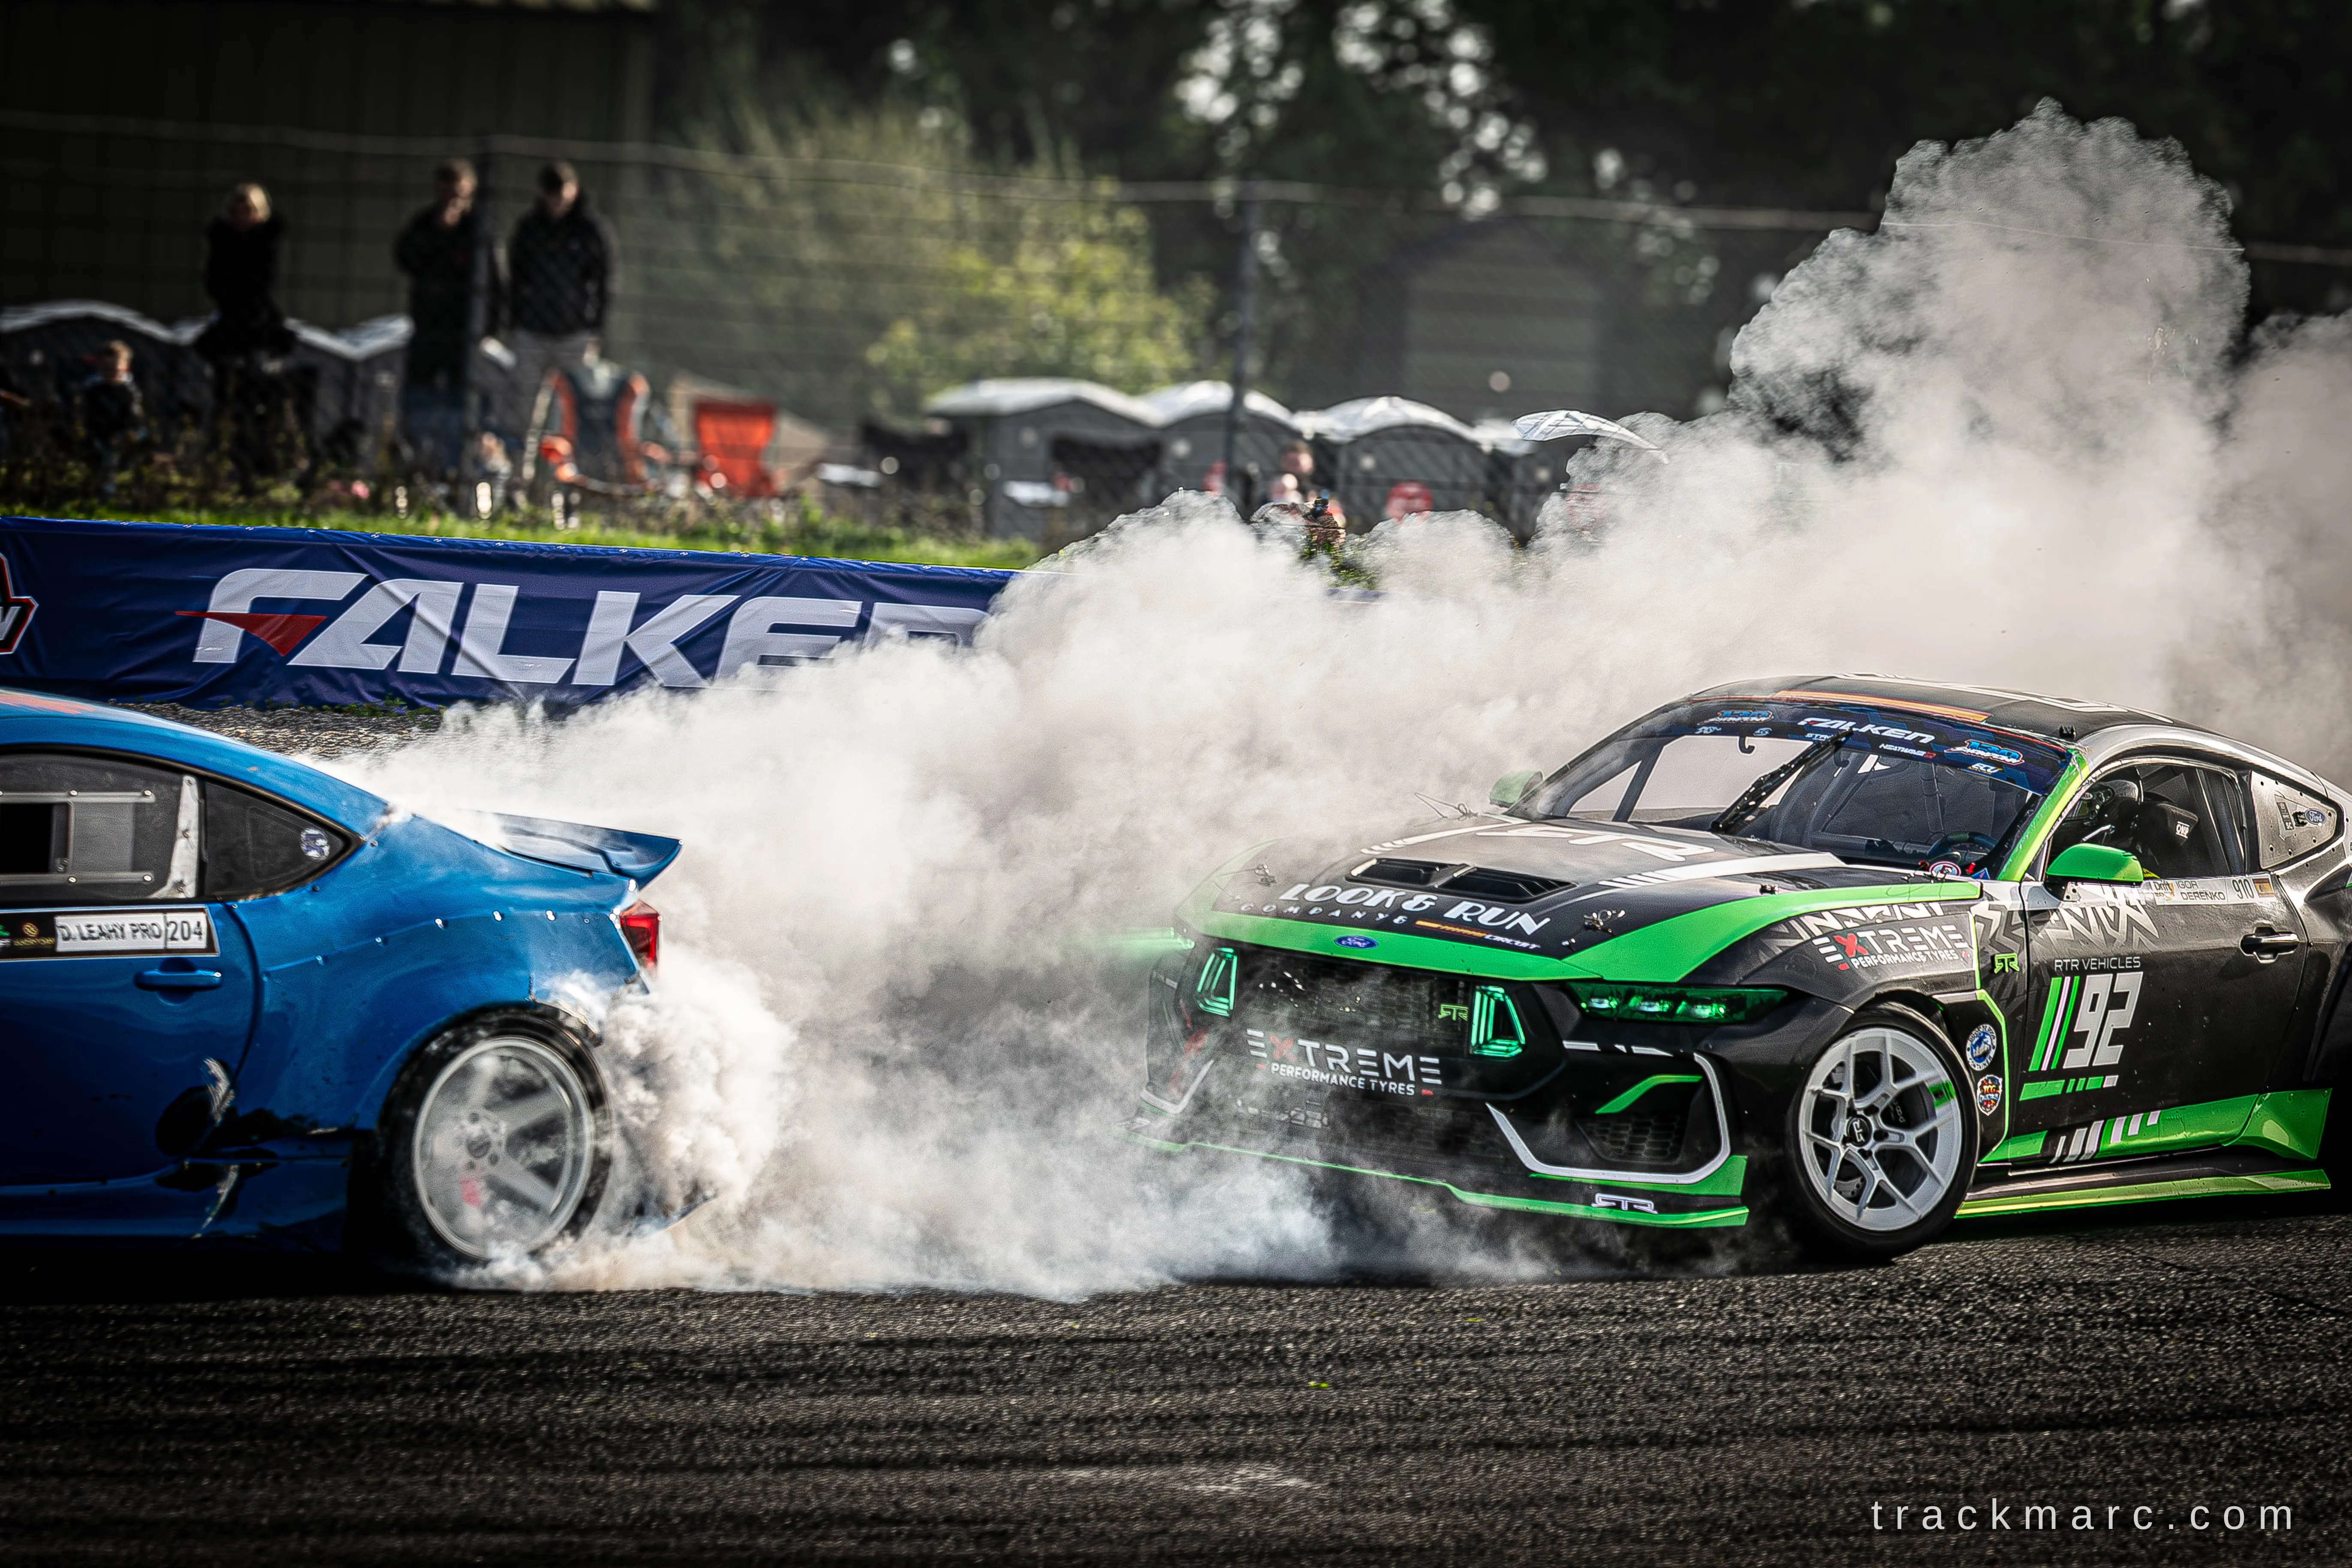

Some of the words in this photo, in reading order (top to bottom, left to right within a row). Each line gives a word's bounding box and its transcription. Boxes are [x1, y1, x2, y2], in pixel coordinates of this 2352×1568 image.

[1798, 717, 1935, 743] FALKEN
[2176, 880, 2198, 889] IGOR
[2232, 879, 2255, 899] 910
[2180, 891, 2226, 900] DERENKO
[1279, 884, 1406, 908] LOOK
[1401, 894, 1438, 912] &
[1443, 901, 1551, 935] RUN
[77, 922, 125, 940] LEAHY
[129, 922, 163, 939] PRO
[167, 921, 203, 941] 204
[1812, 924, 1970, 963] EXTREME
[1850, 950, 1926, 969] PERFORMANCE
[1924, 949, 1958, 962] TYRES
[2054, 959, 2080, 972] RTR
[2082, 956, 2141, 970] VEHICLES
[2062, 971, 2144, 1069] 92
[1246, 1029, 1442, 1085] EXTREME
[1271, 1062, 1365, 1090] PERFORMANCE
[1370, 1079, 1415, 1096] TYRES
